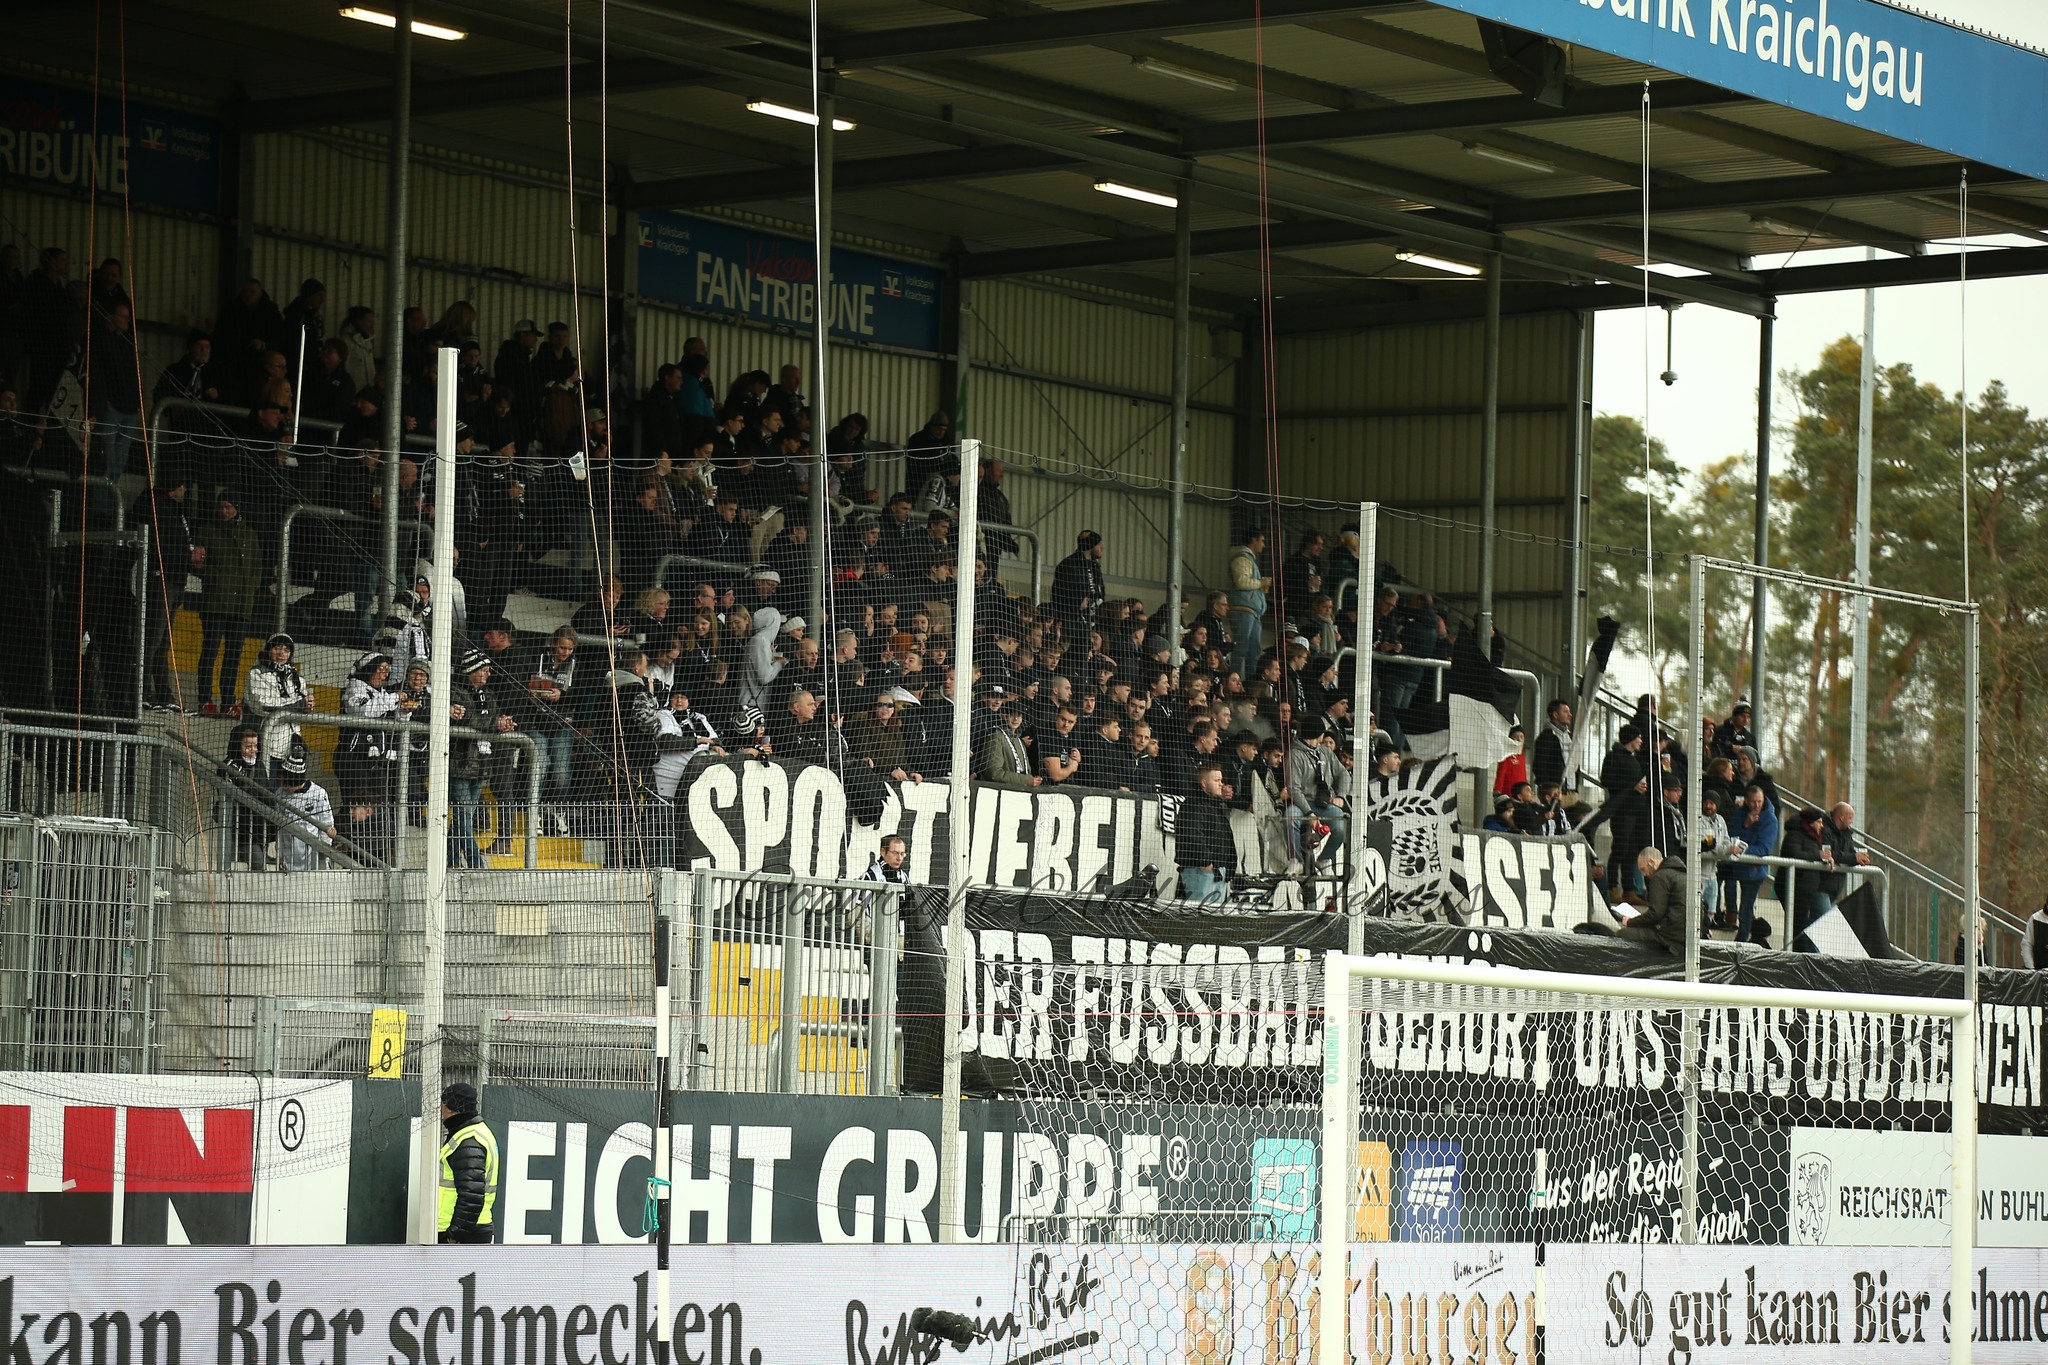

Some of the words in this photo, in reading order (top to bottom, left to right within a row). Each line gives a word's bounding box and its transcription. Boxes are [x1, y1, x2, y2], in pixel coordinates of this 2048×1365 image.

[1579, 0, 1696, 39] ank
[1709, 0, 1923, 111] Kraichgau
[656, 222, 691, 241] Volksbank
[656, 239, 690, 256] Kraichgau
[904, 273, 935, 290] Volksbank
[1069, 935, 1325, 1068] FUSSBAL
[1677, 1004, 1794, 1098] ANS
[1898, 1002, 2043, 1108] KENEN
[380, 1038, 392, 1073] 8
[1325, 1024, 1339, 1085] VINDICO
[407, 1116, 793, 1245] EICHT
[1580, 1156, 1618, 1205] der
[1627, 1147, 1684, 1207] Regio
[1839, 1186, 1947, 1220] REICHSRAT
[1670, 1192, 1751, 1244] Rgion!
[214, 1279, 364, 1365] Bier
[1605, 1269, 1654, 1348] So
[1668, 1277, 1733, 1365] gut
[1744, 1265, 1840, 1346] kann
[1853, 1269, 1930, 1345] Bier
